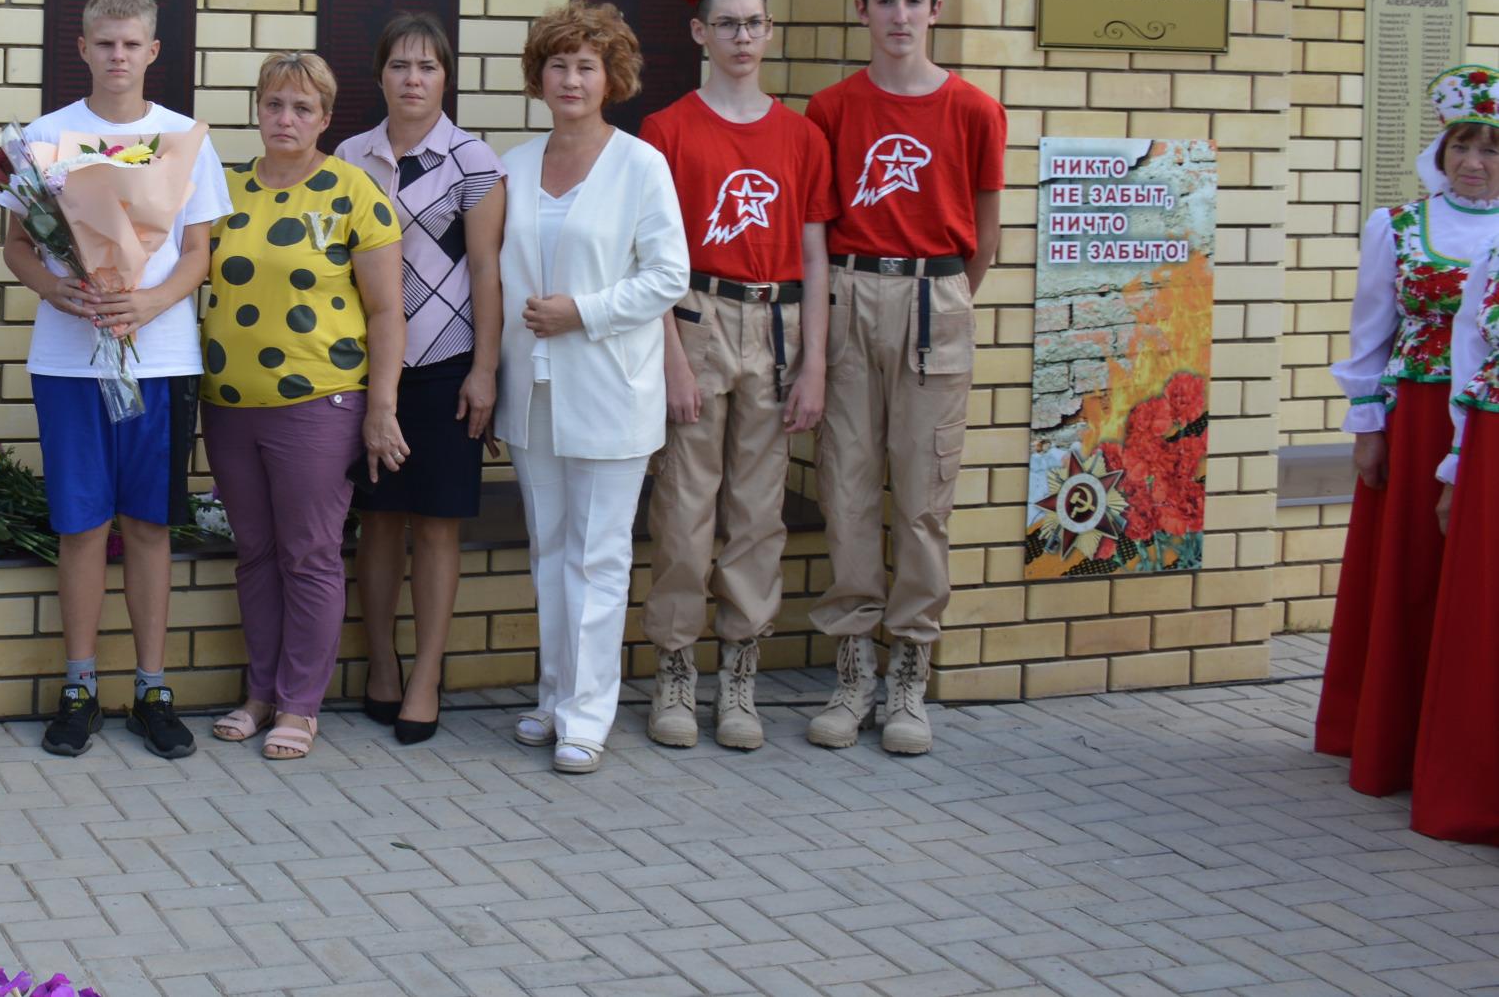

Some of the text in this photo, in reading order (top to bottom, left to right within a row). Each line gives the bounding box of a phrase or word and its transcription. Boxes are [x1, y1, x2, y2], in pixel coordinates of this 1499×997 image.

[1053, 158, 1126, 175] НИКТО
[1052, 187, 1174, 209] НЕ ЗАБЫТ,
[1051, 215, 1126, 232] НИЧТО
[1050, 243, 1187, 260] НЕ ЗАБЫТО!
